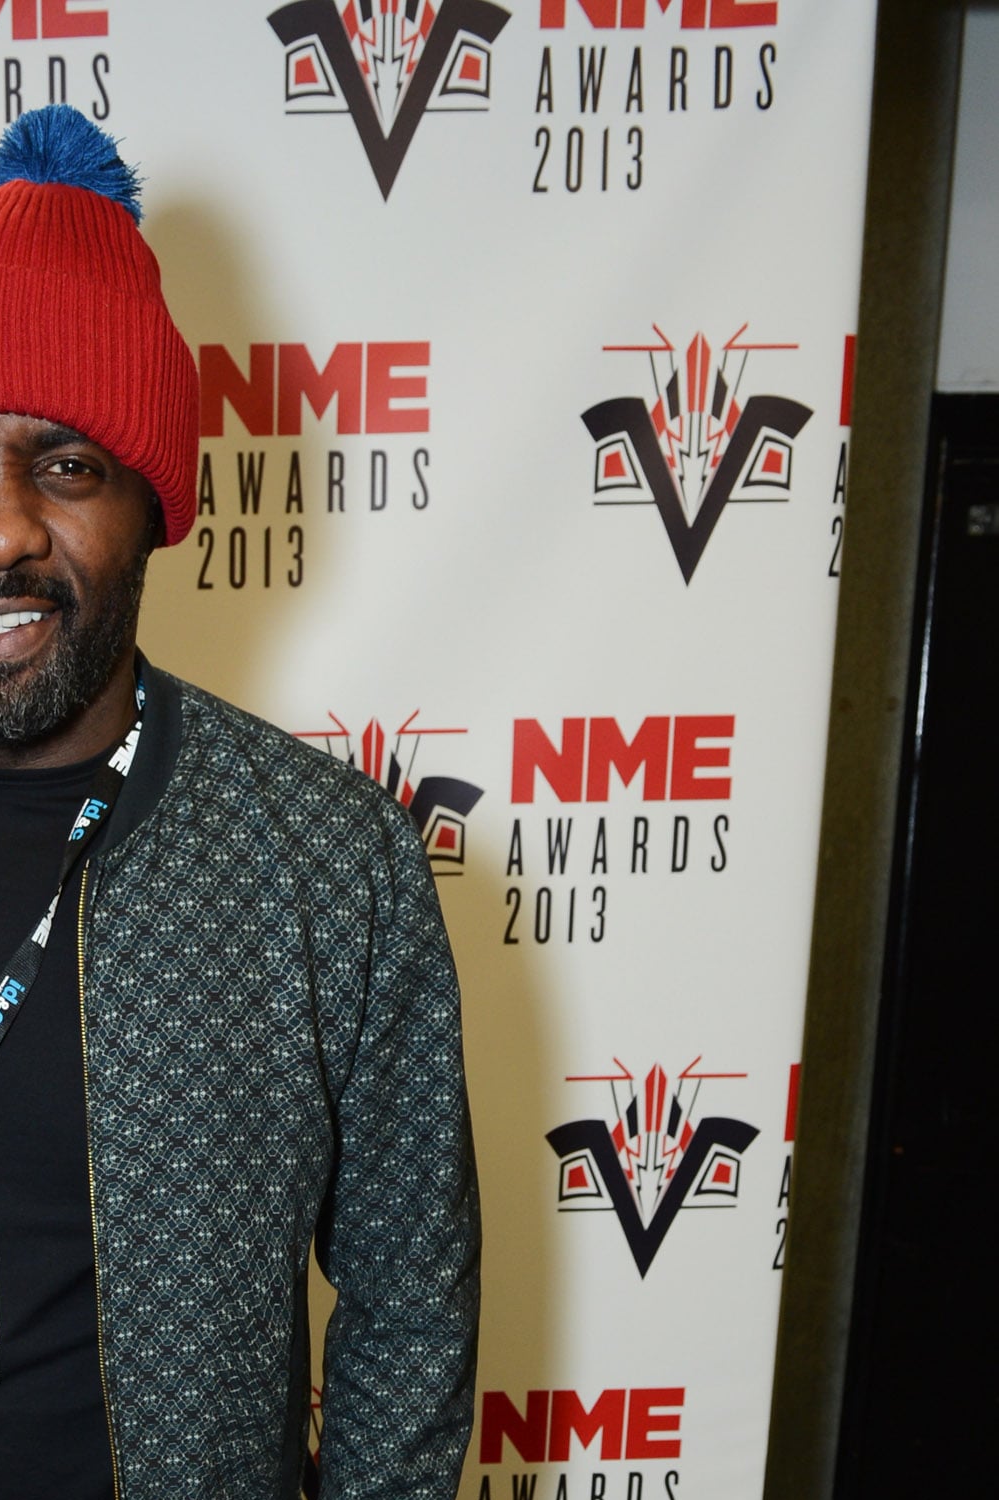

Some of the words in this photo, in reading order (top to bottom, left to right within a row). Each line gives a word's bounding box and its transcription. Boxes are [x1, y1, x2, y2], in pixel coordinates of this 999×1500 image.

[536, 42, 777, 114] AWARDS
[532, 126, 644, 193] 2013
[199, 341, 430, 437] NME
[197, 448, 430, 517] AWARDS
[197, 527, 304, 590] 2013
[510, 715, 735, 804] NME
[506, 815, 730, 877] AWARDS
[503, 886, 607, 945] 2013
[479, 1387, 685, 1464] NME
